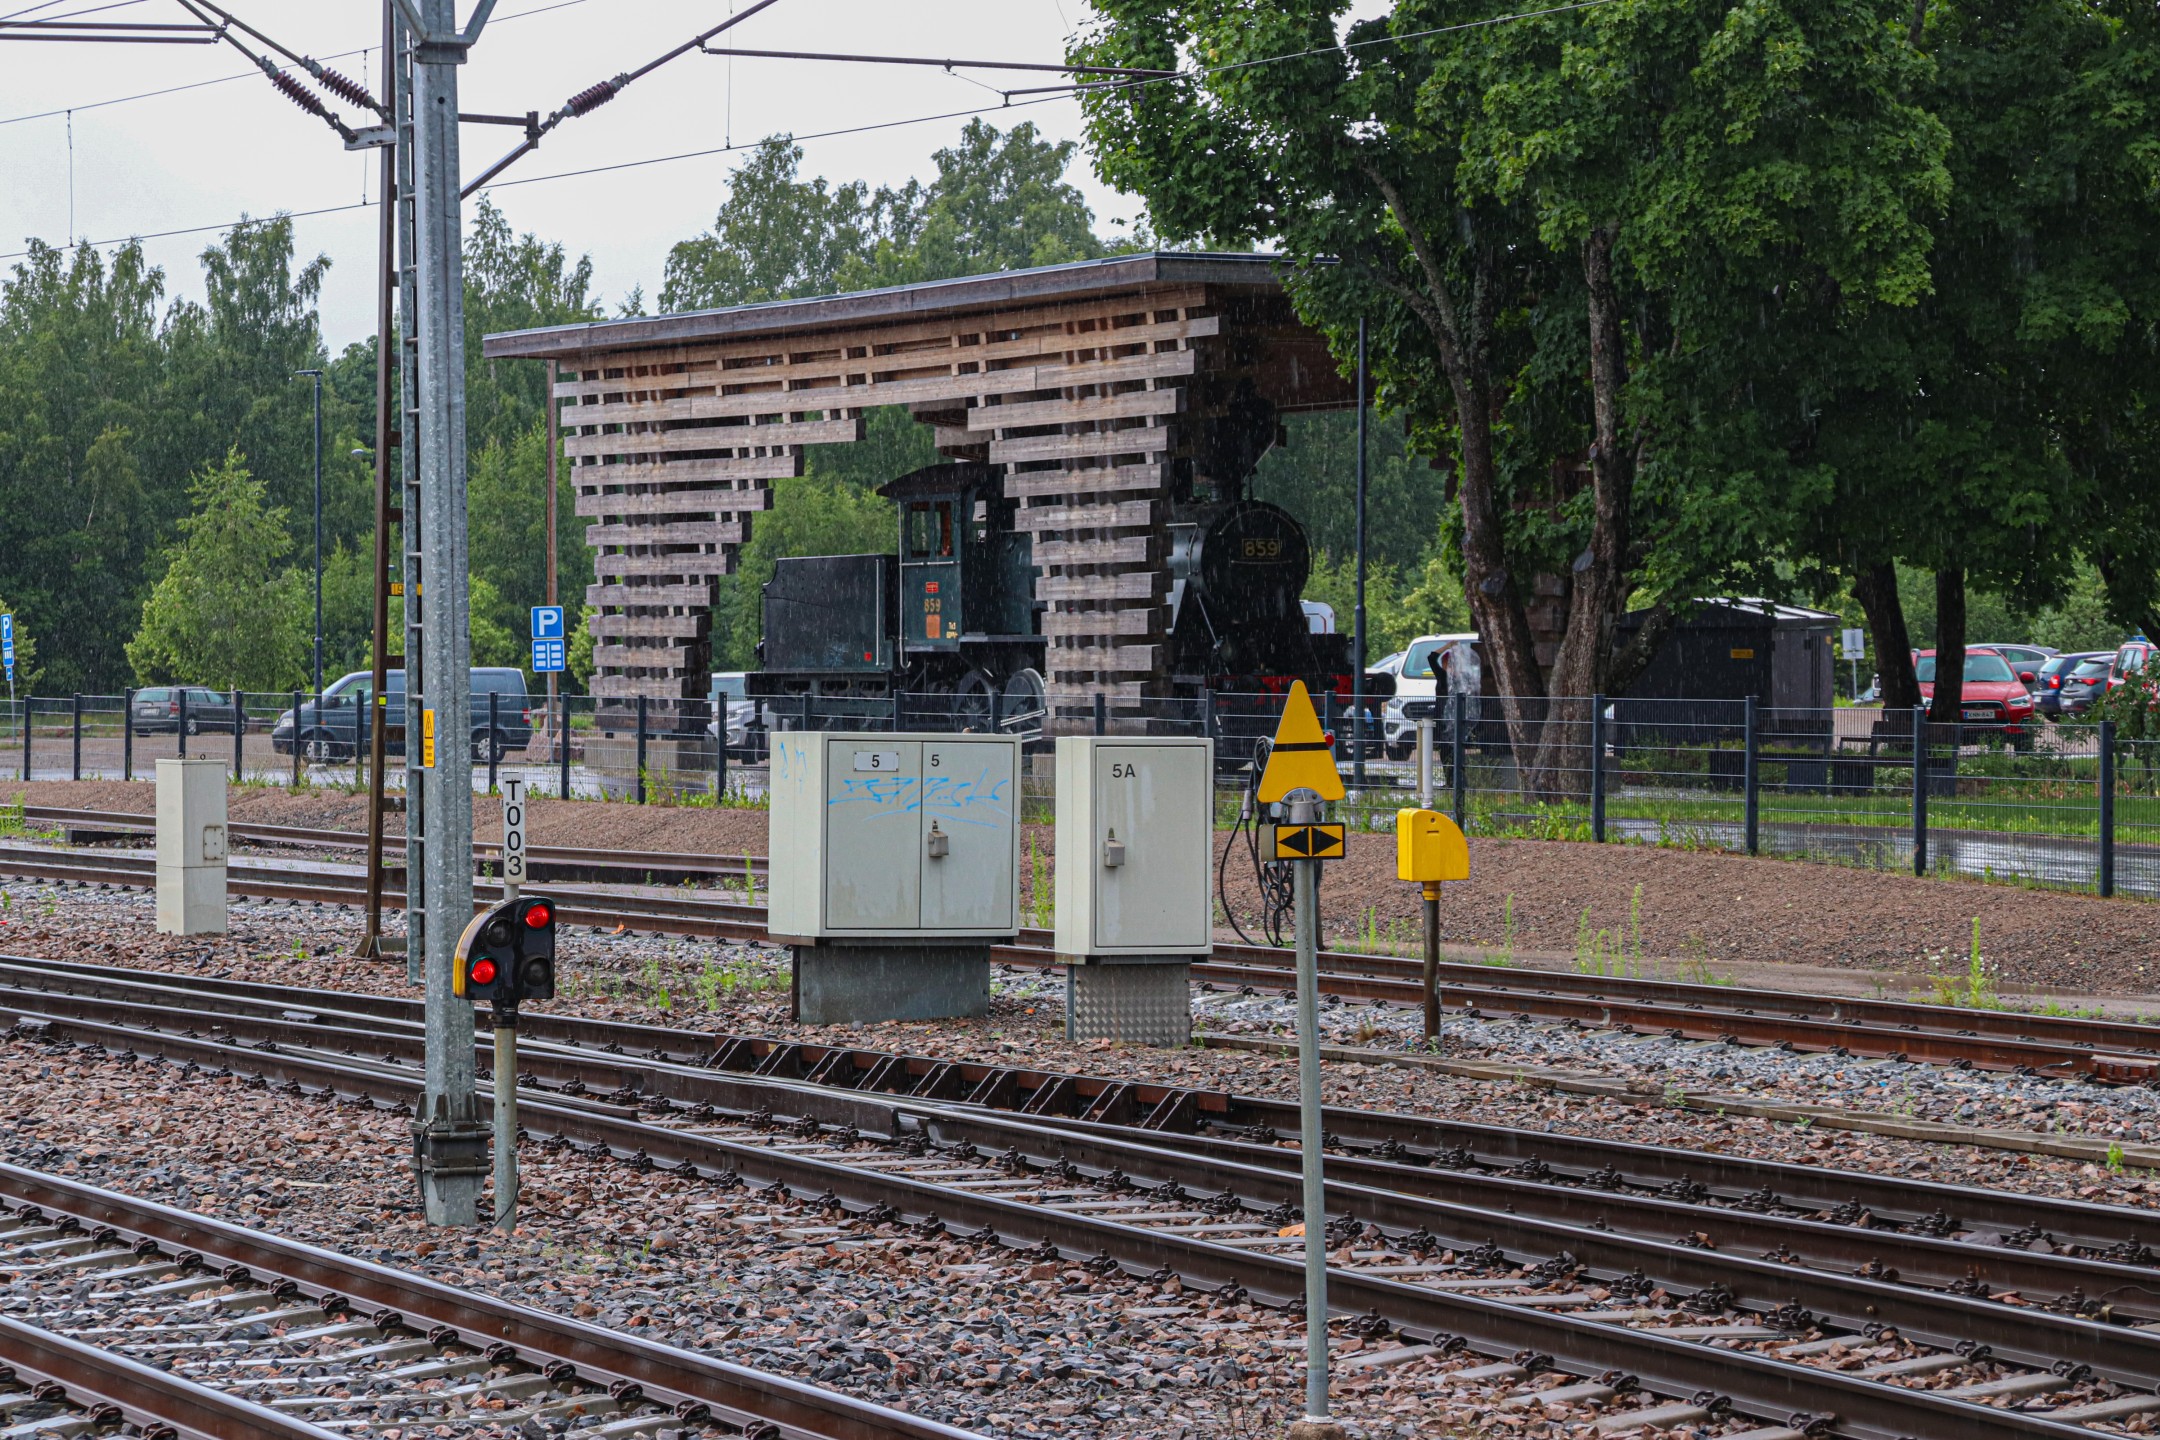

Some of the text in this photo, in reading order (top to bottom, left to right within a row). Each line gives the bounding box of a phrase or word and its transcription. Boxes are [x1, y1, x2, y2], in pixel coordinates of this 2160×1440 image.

[1245, 541, 1278, 557] 859
[924, 599, 941, 613] 859
[3, 617, 9, 638] P
[539, 610, 558, 635] P
[871, 754, 880, 768] 5
[931, 754, 940, 767] 5
[1112, 763, 1136, 778] 5A
[505, 780, 522, 876] T003
